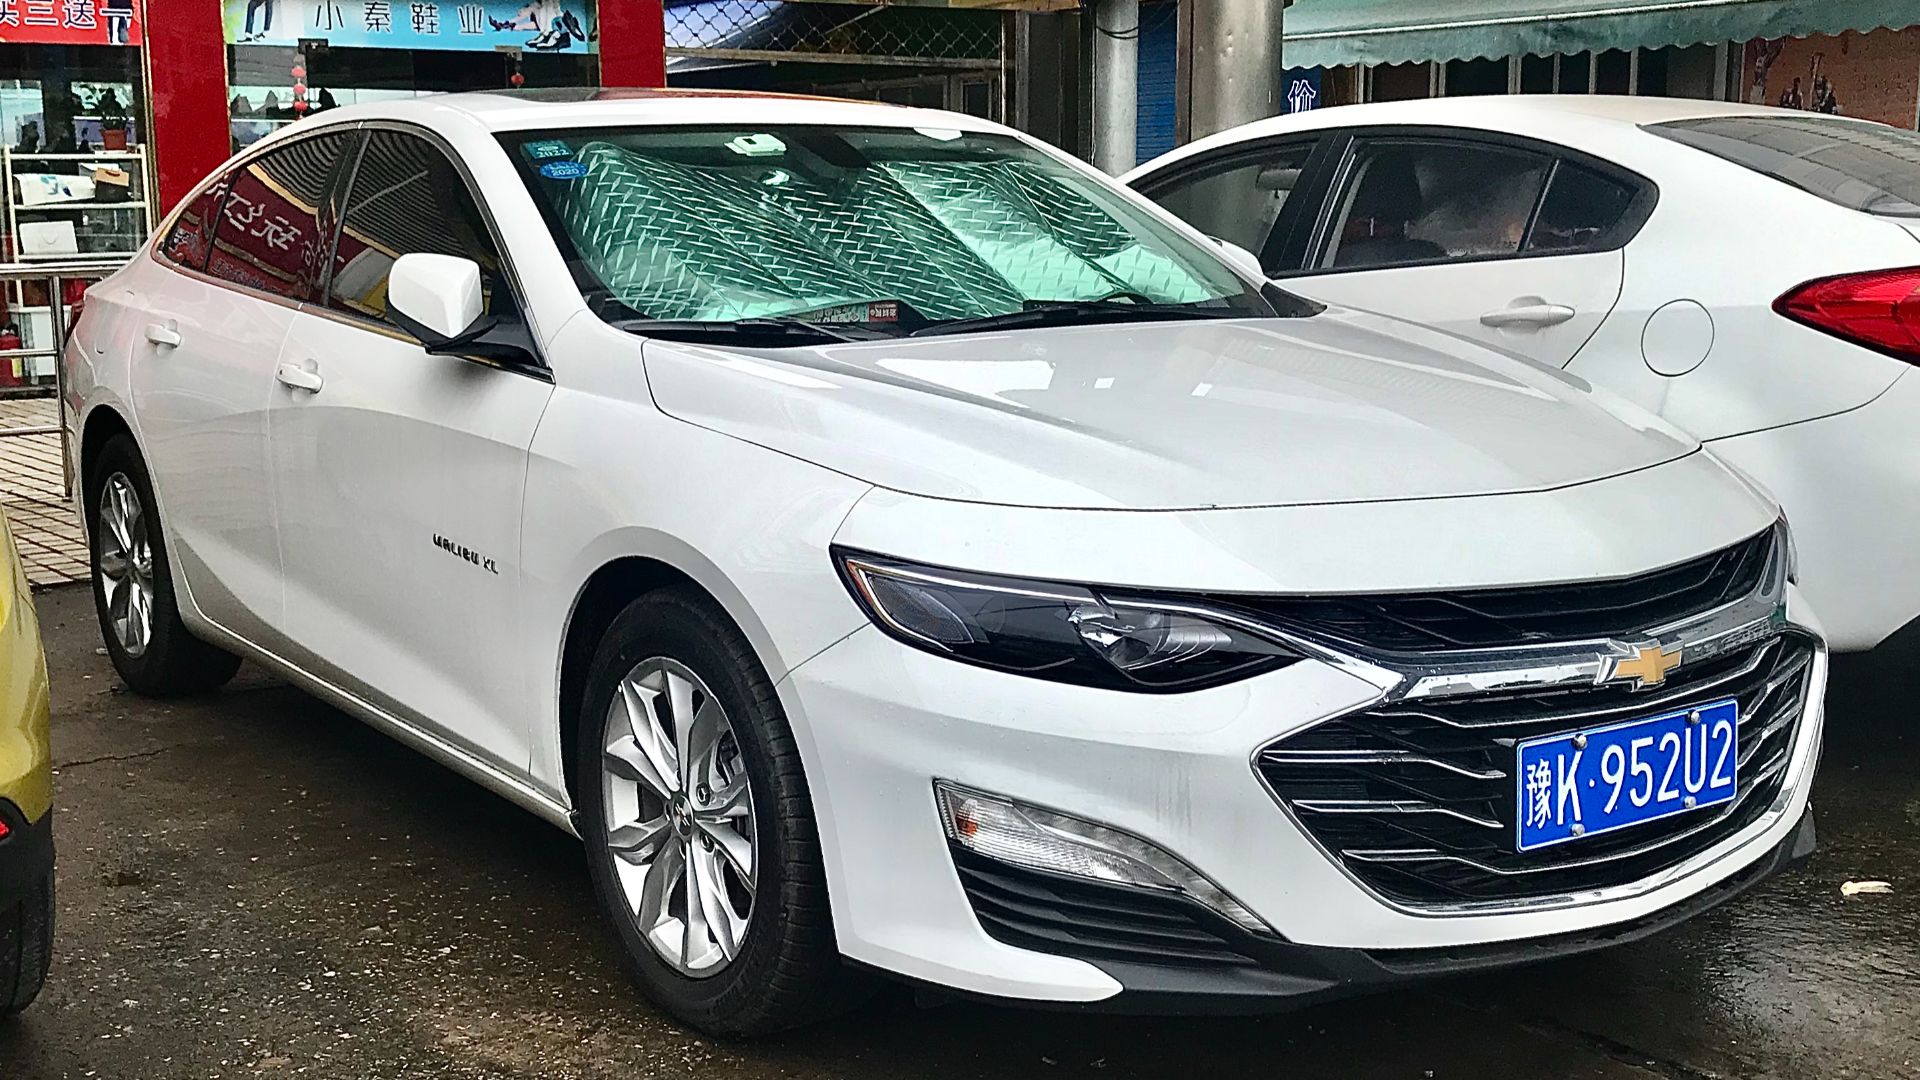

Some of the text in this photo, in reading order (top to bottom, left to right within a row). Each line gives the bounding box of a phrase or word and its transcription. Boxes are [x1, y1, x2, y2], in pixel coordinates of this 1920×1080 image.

[314, 0, 484, 35] 小秦鞋业
[483, 555, 499, 575] XL
